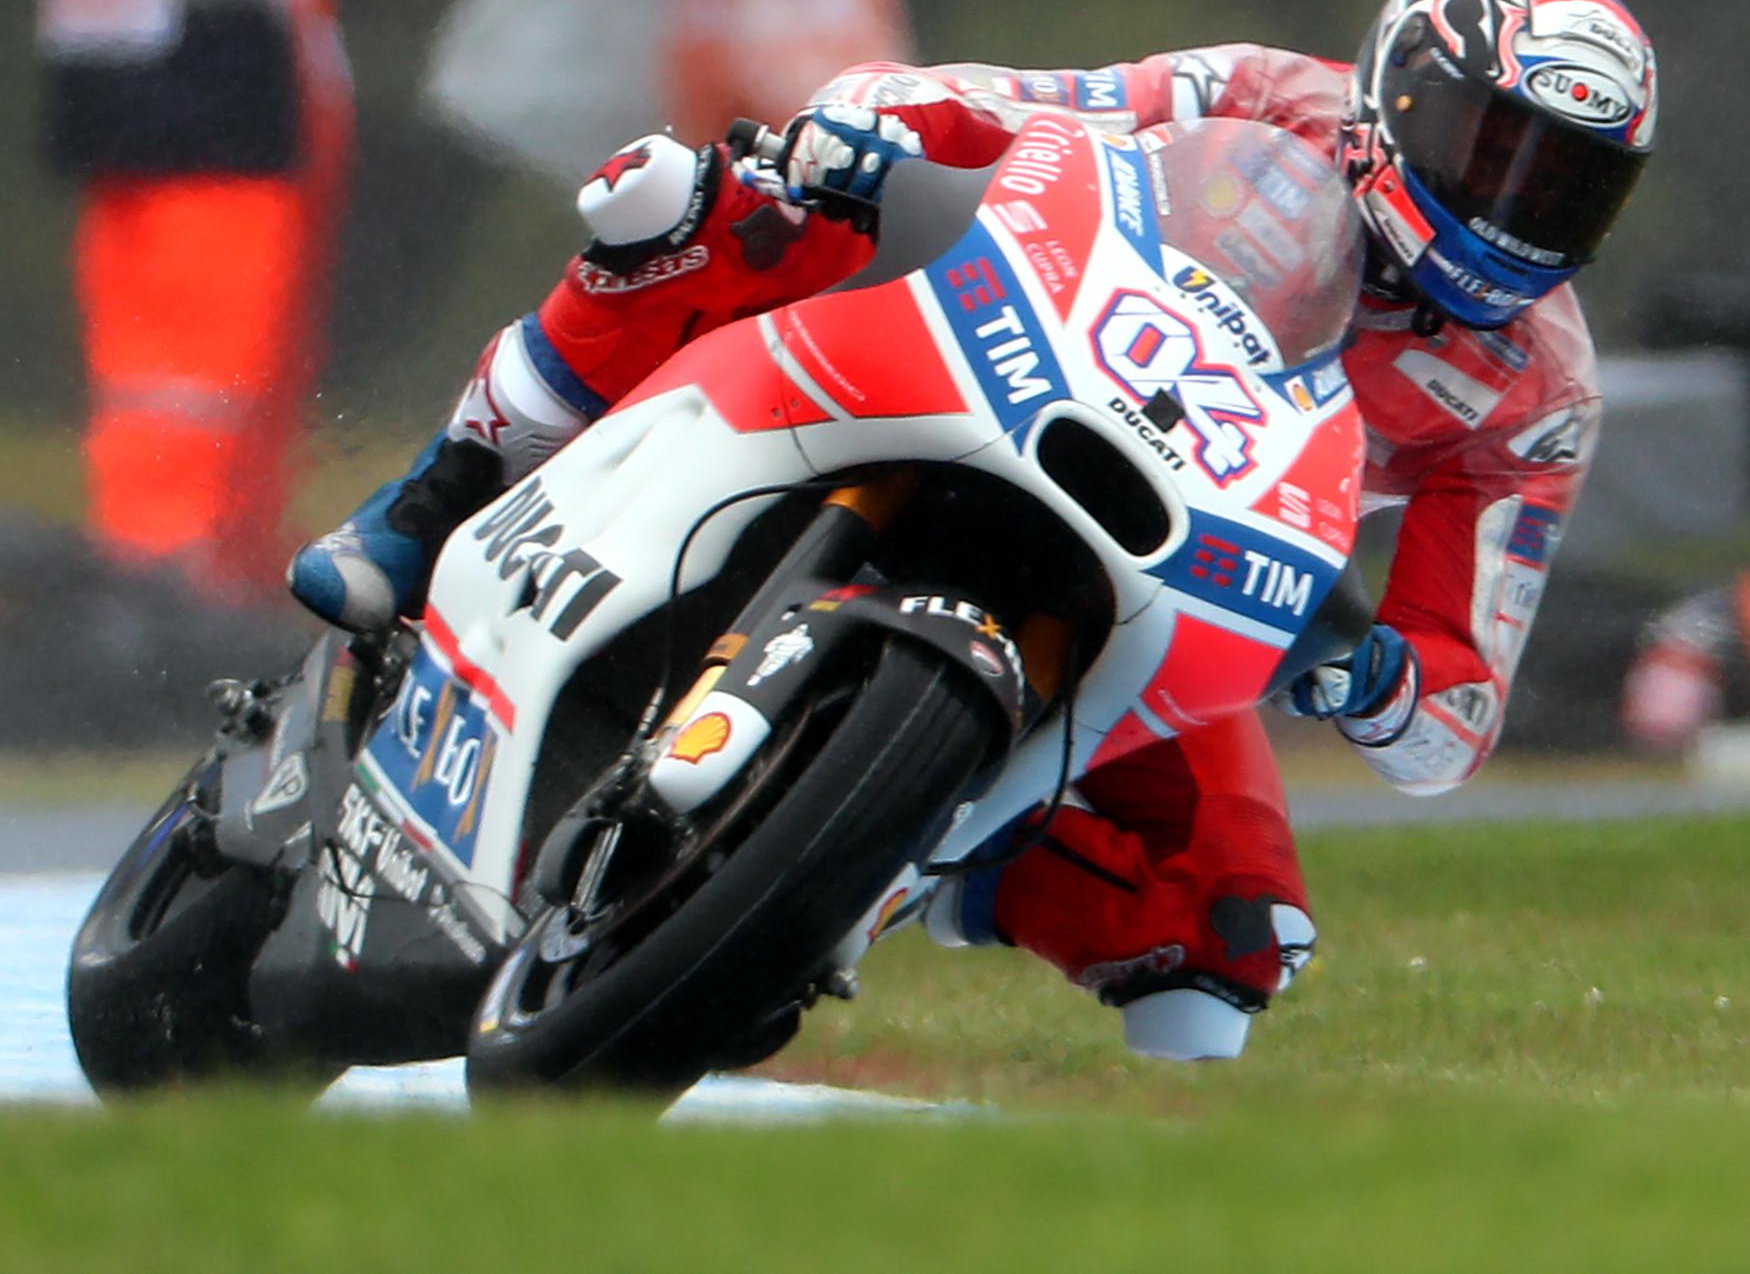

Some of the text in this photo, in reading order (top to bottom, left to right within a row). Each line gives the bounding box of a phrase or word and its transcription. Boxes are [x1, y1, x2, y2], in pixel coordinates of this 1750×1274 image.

[975, 304, 1053, 405] TIM
[1087, 287, 1267, 490] 04
[1107, 397, 1187, 471] DUCATI
[1425, 378, 1480, 421] DUCATI
[1242, 549, 1315, 617] TIM
